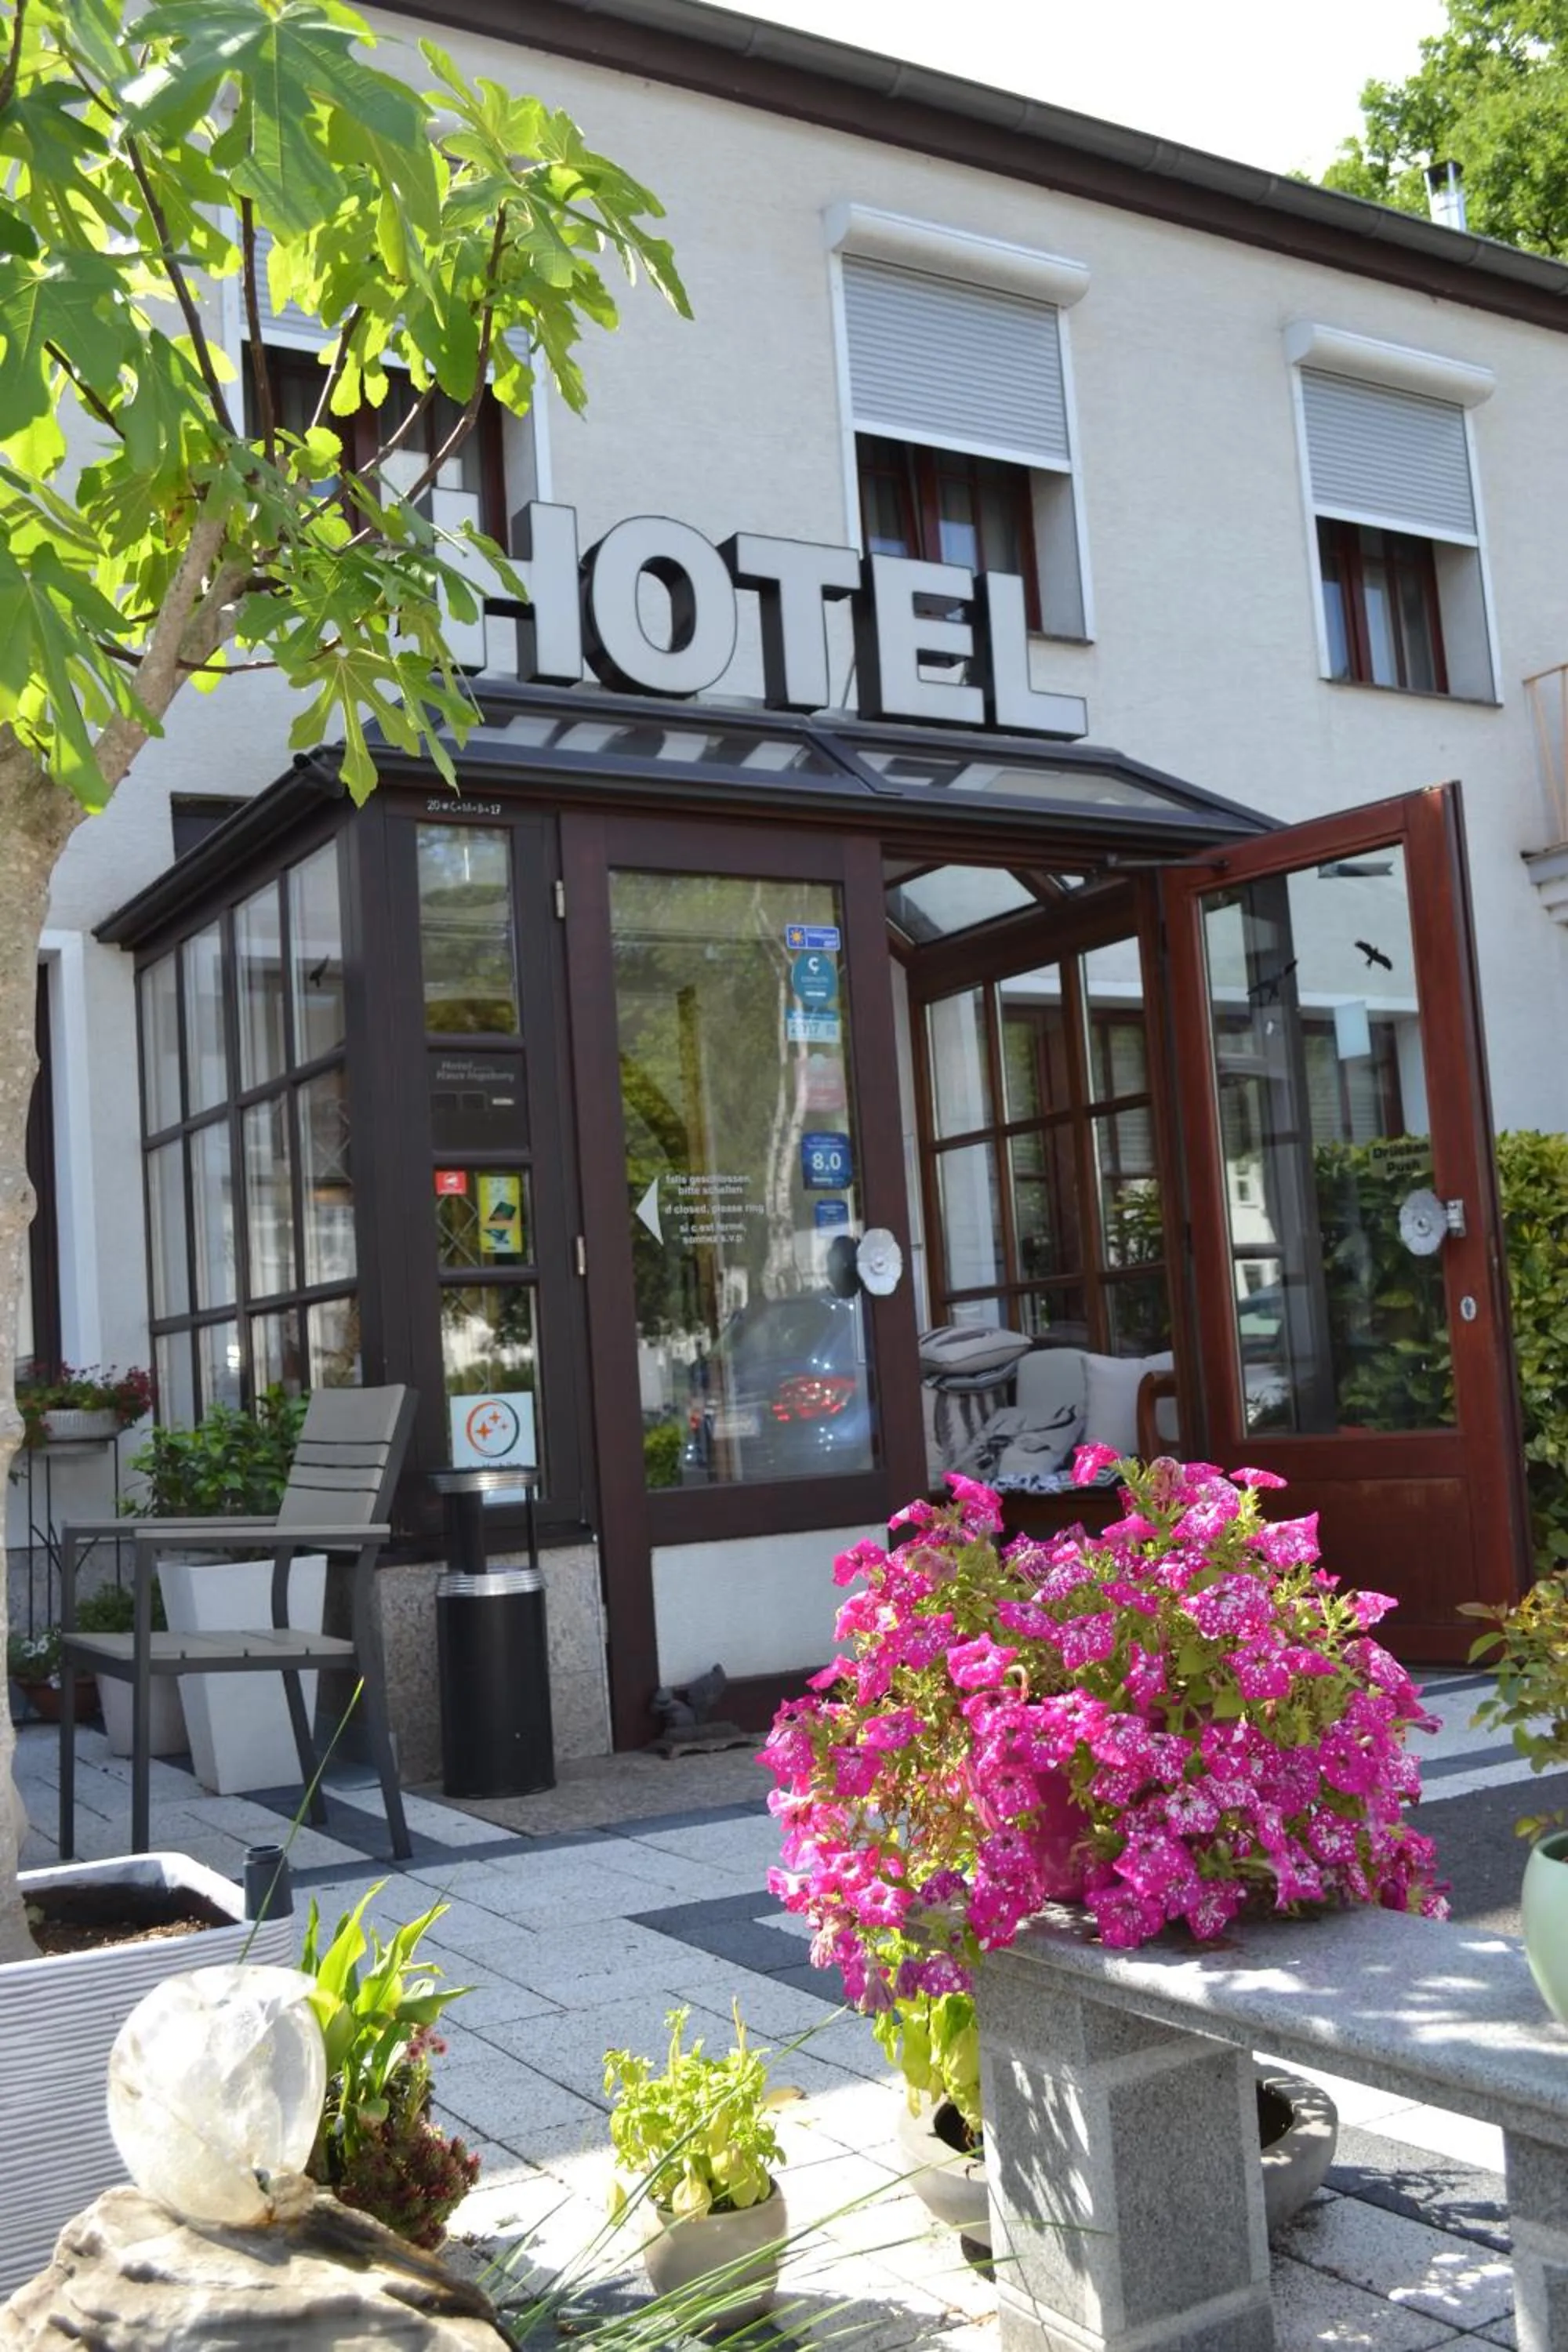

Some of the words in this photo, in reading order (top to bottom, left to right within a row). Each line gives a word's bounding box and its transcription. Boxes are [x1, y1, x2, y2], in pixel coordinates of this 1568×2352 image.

[423, 487, 1088, 739] HOTEL
[1386, 1159, 1421, 1174] Push
[745, 1203, 764, 1215] ring
